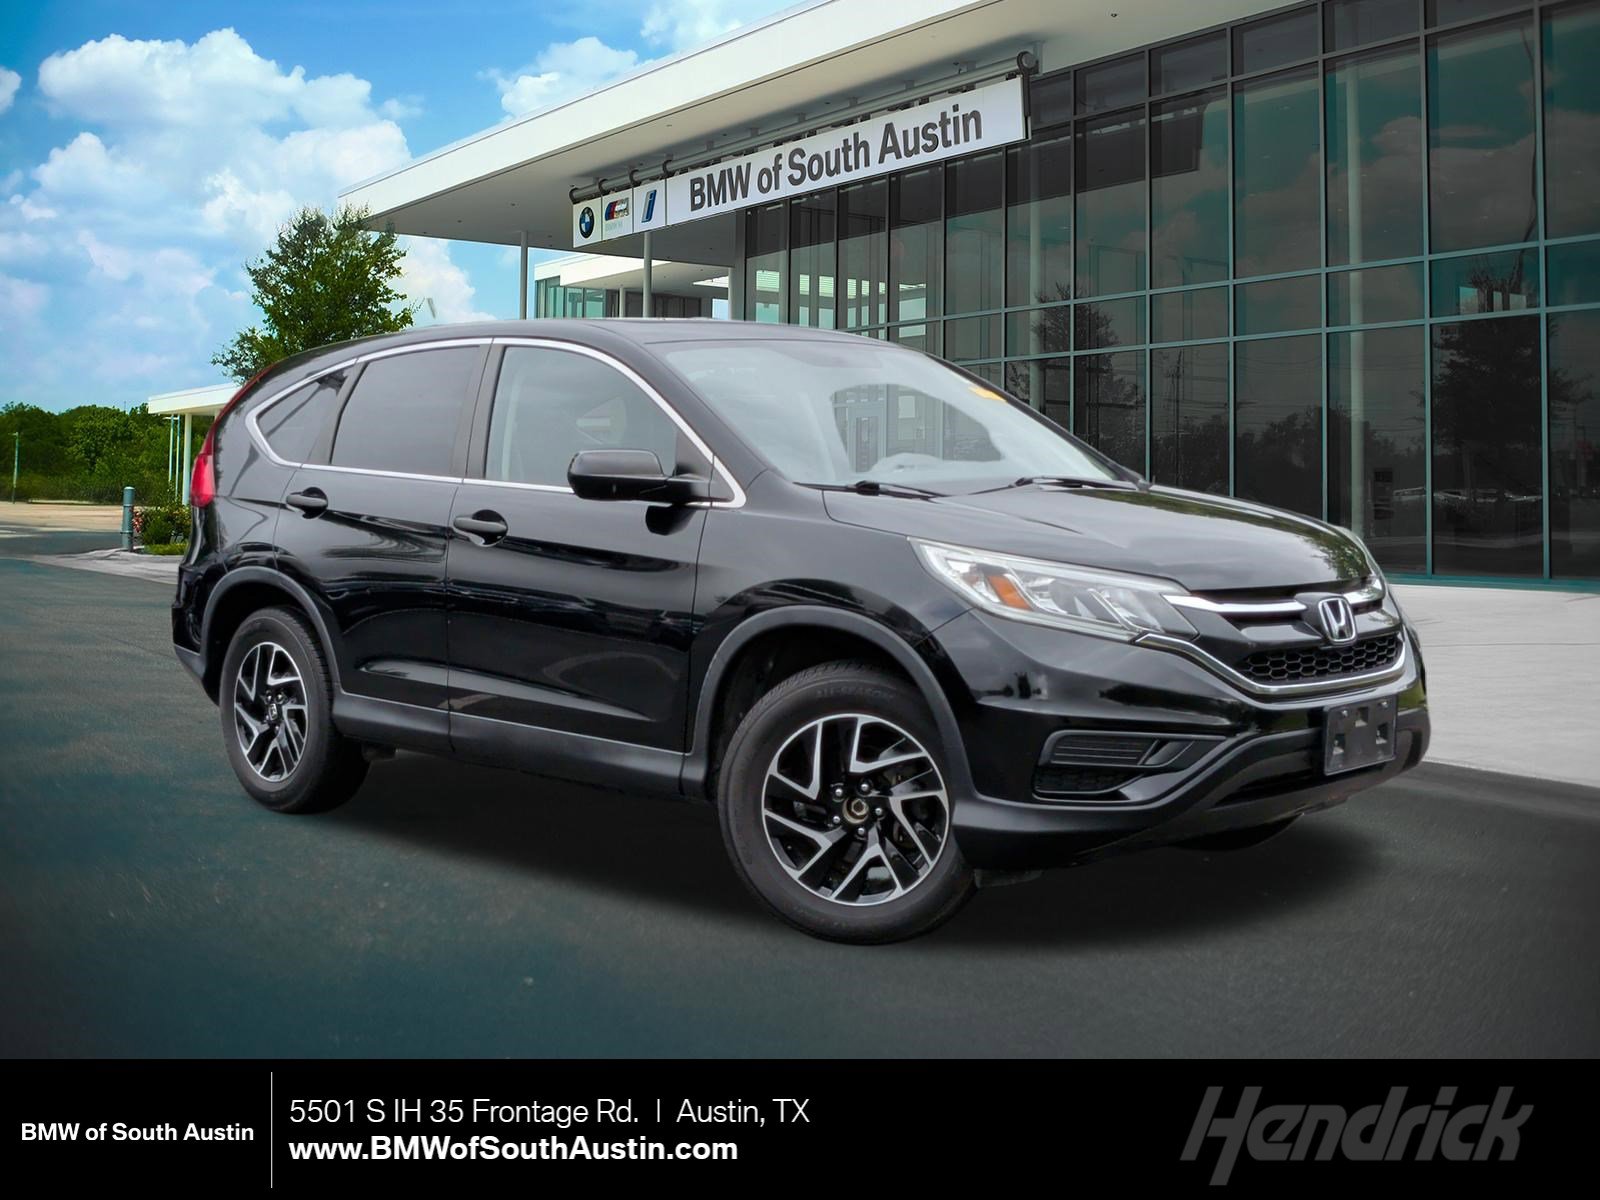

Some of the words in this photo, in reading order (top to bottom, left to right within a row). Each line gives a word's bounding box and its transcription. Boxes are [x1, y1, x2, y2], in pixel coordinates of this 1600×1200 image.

[690, 162, 752, 212] BMW
[757, 153, 783, 194] of
[787, 132, 870, 186] South
[878, 104, 983, 164] Austin
